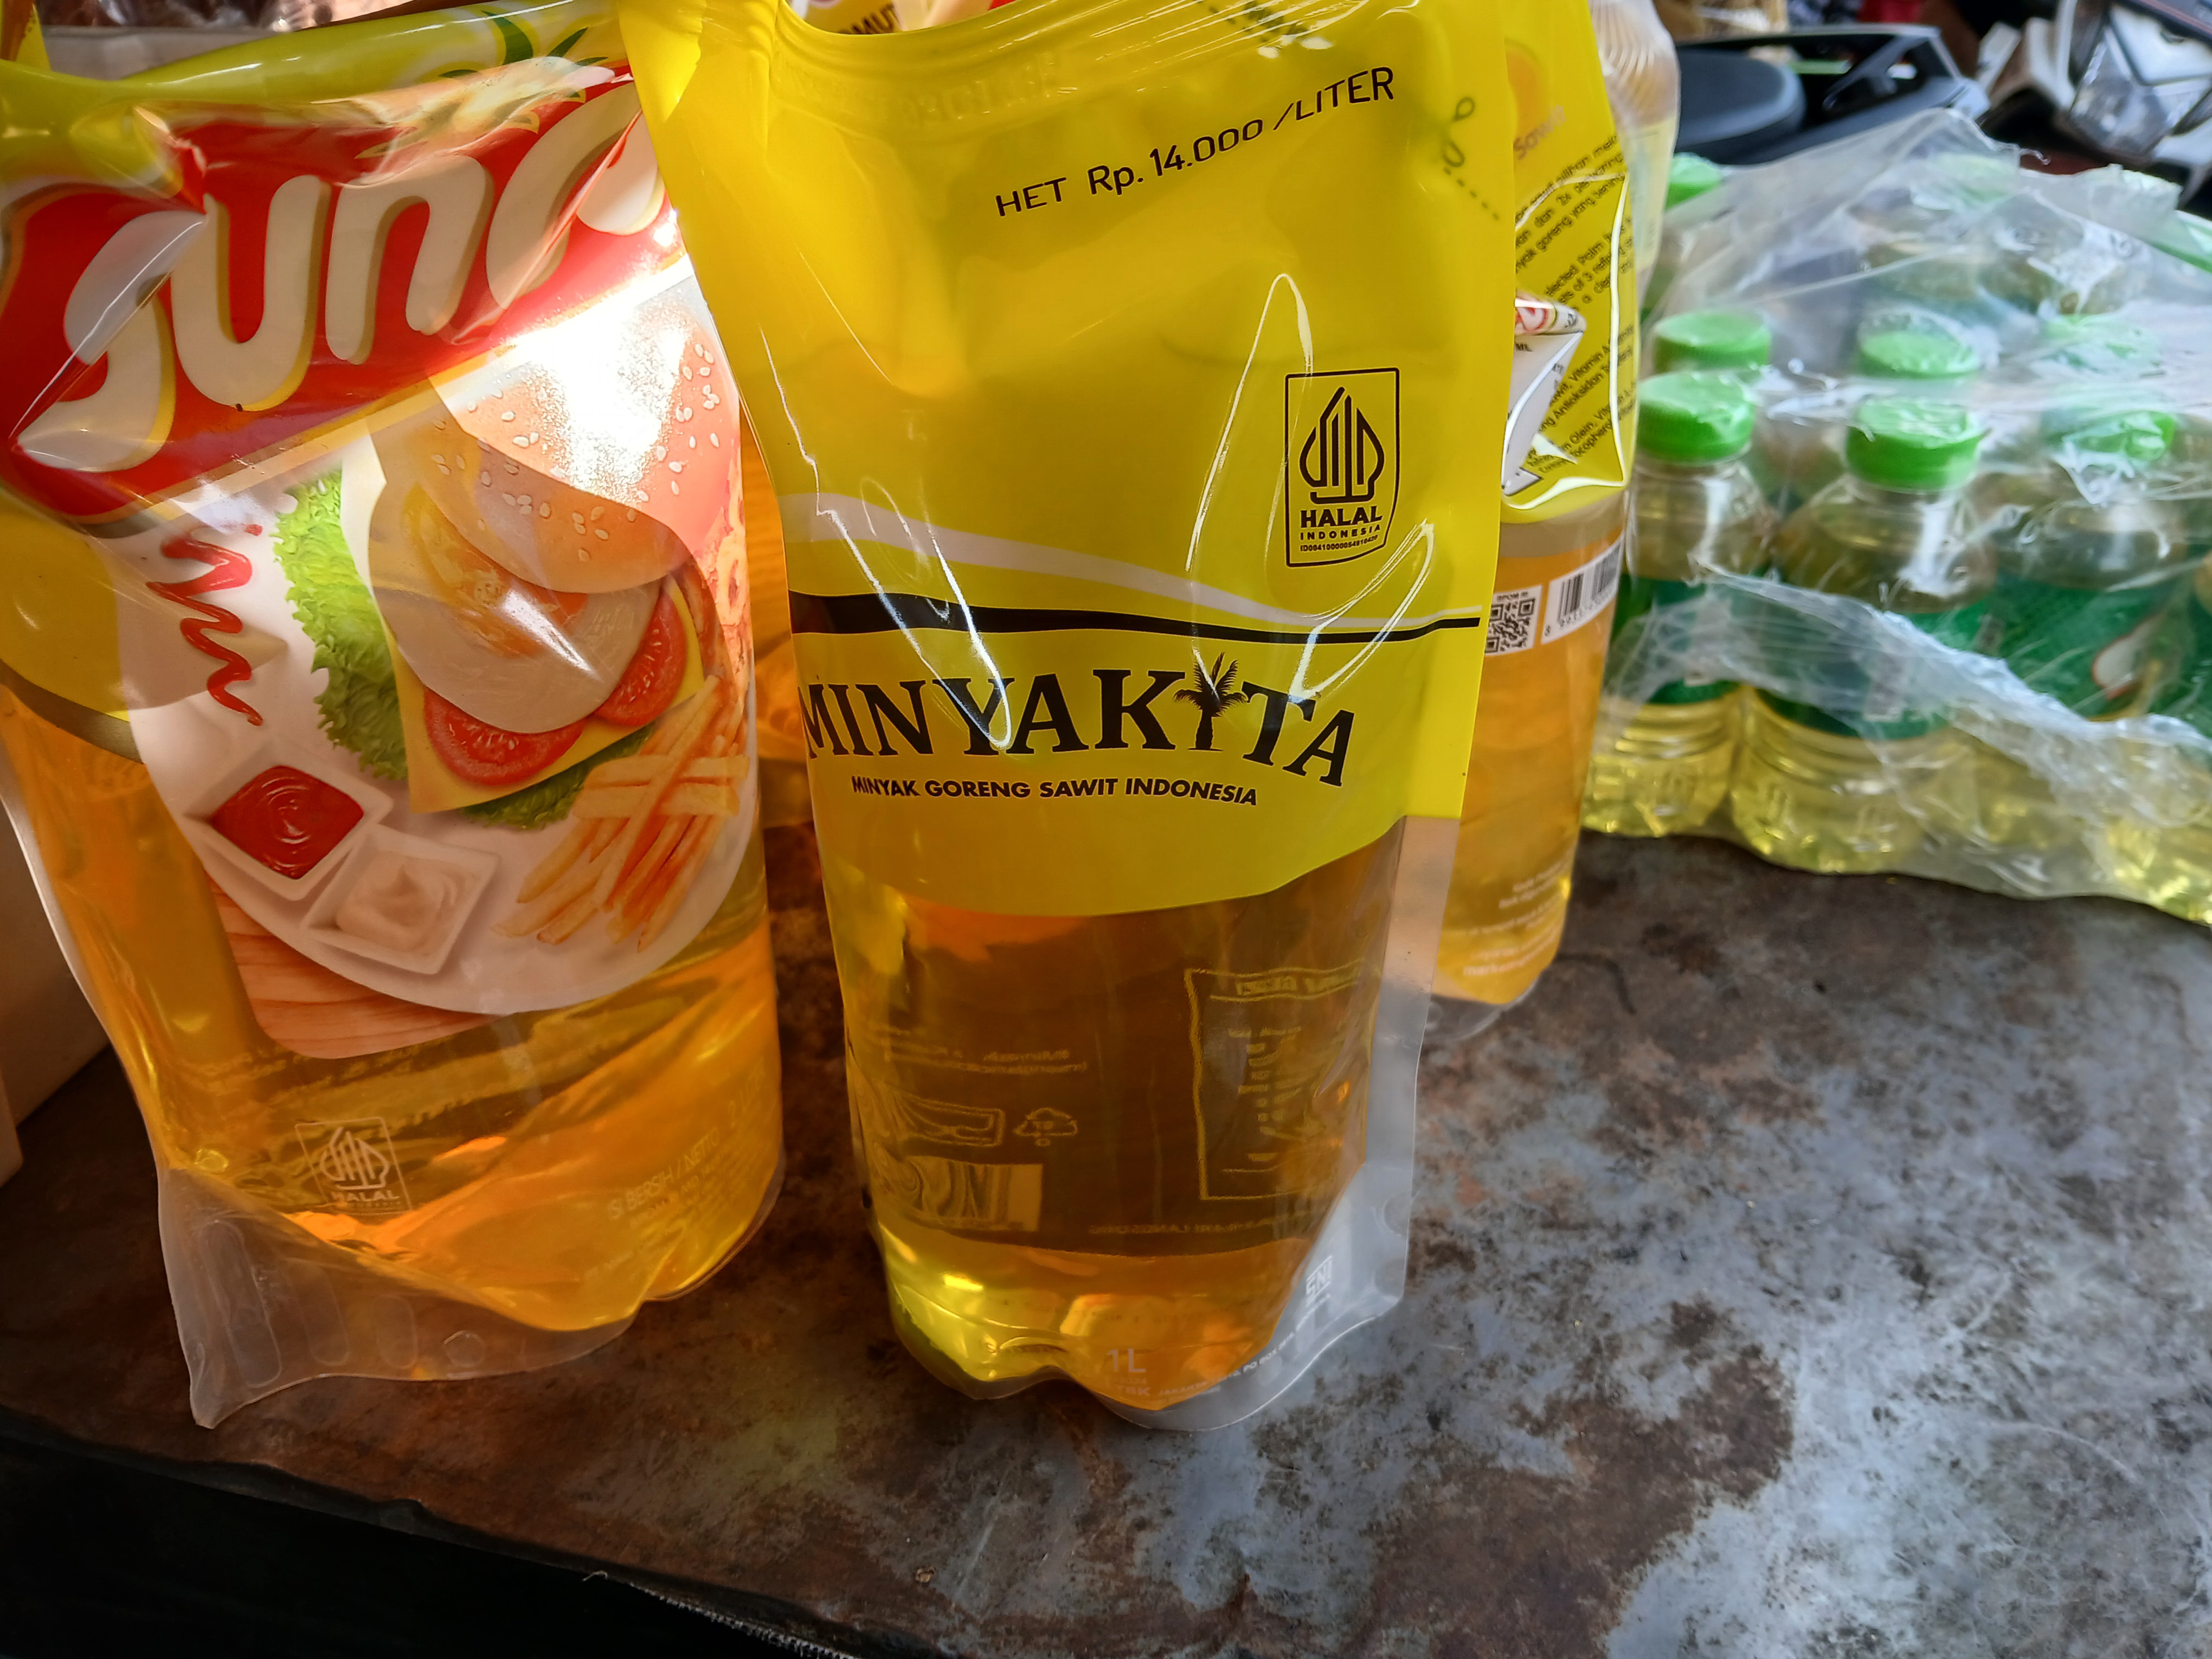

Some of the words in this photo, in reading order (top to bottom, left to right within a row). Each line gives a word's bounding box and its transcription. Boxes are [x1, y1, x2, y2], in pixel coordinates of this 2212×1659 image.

[995, 177, 1066, 216] HET
[1087, 165, 1144, 196] Rp.
[1149, 118, 1263, 177] 14.000
[1272, 66, 1394, 131] /LITER
[1535, 215, 1574, 253] goreng
[1571, 195, 1596, 219] yang
[1568, 352, 1604, 382] Vitamin
[1552, 372, 1604, 421] Antioksidan
[1300, 505, 1384, 529] HALAL
[1300, 524, 1381, 541] INDONESIA
[851, 775, 922, 797] MINYAK
[924, 780, 1031, 798] GORENG
[1039, 778, 1118, 798] SAWIT
[1125, 777, 1257, 806] INDONESIA
